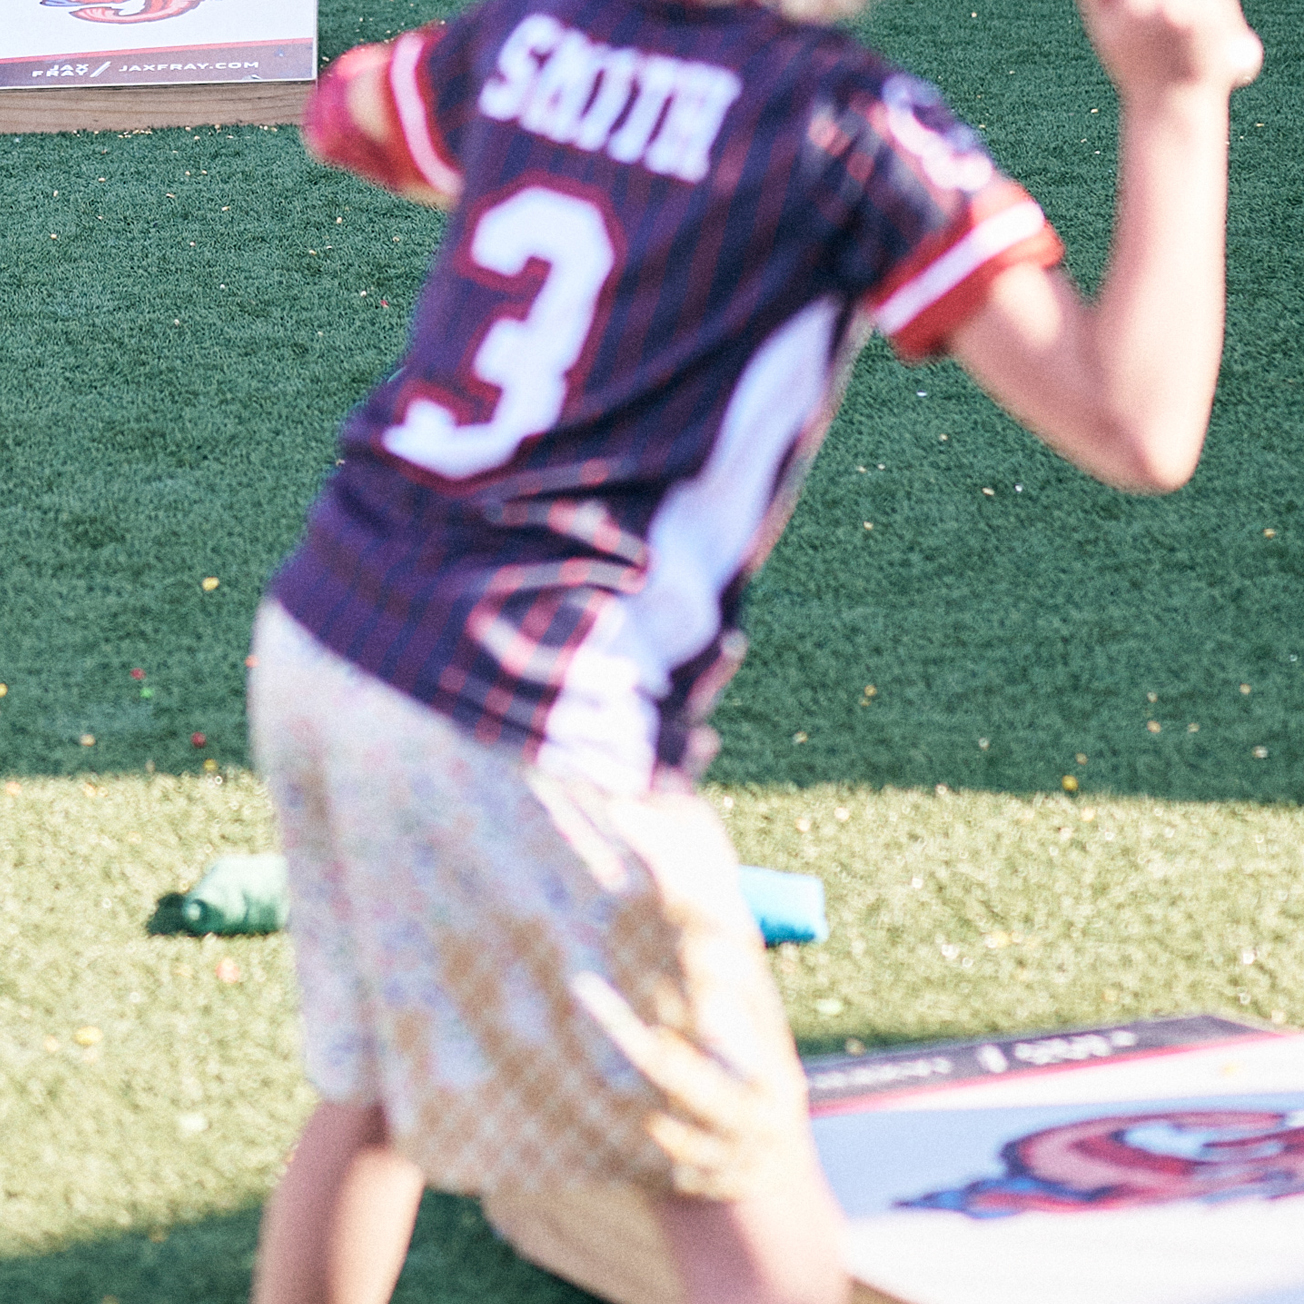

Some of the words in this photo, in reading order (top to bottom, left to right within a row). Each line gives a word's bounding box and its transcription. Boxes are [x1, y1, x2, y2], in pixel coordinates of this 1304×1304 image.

[118, 61, 259, 73] JAXFRAY.COM
[479, 12, 741, 183] SMITH
[382, 185, 616, 481] 3
